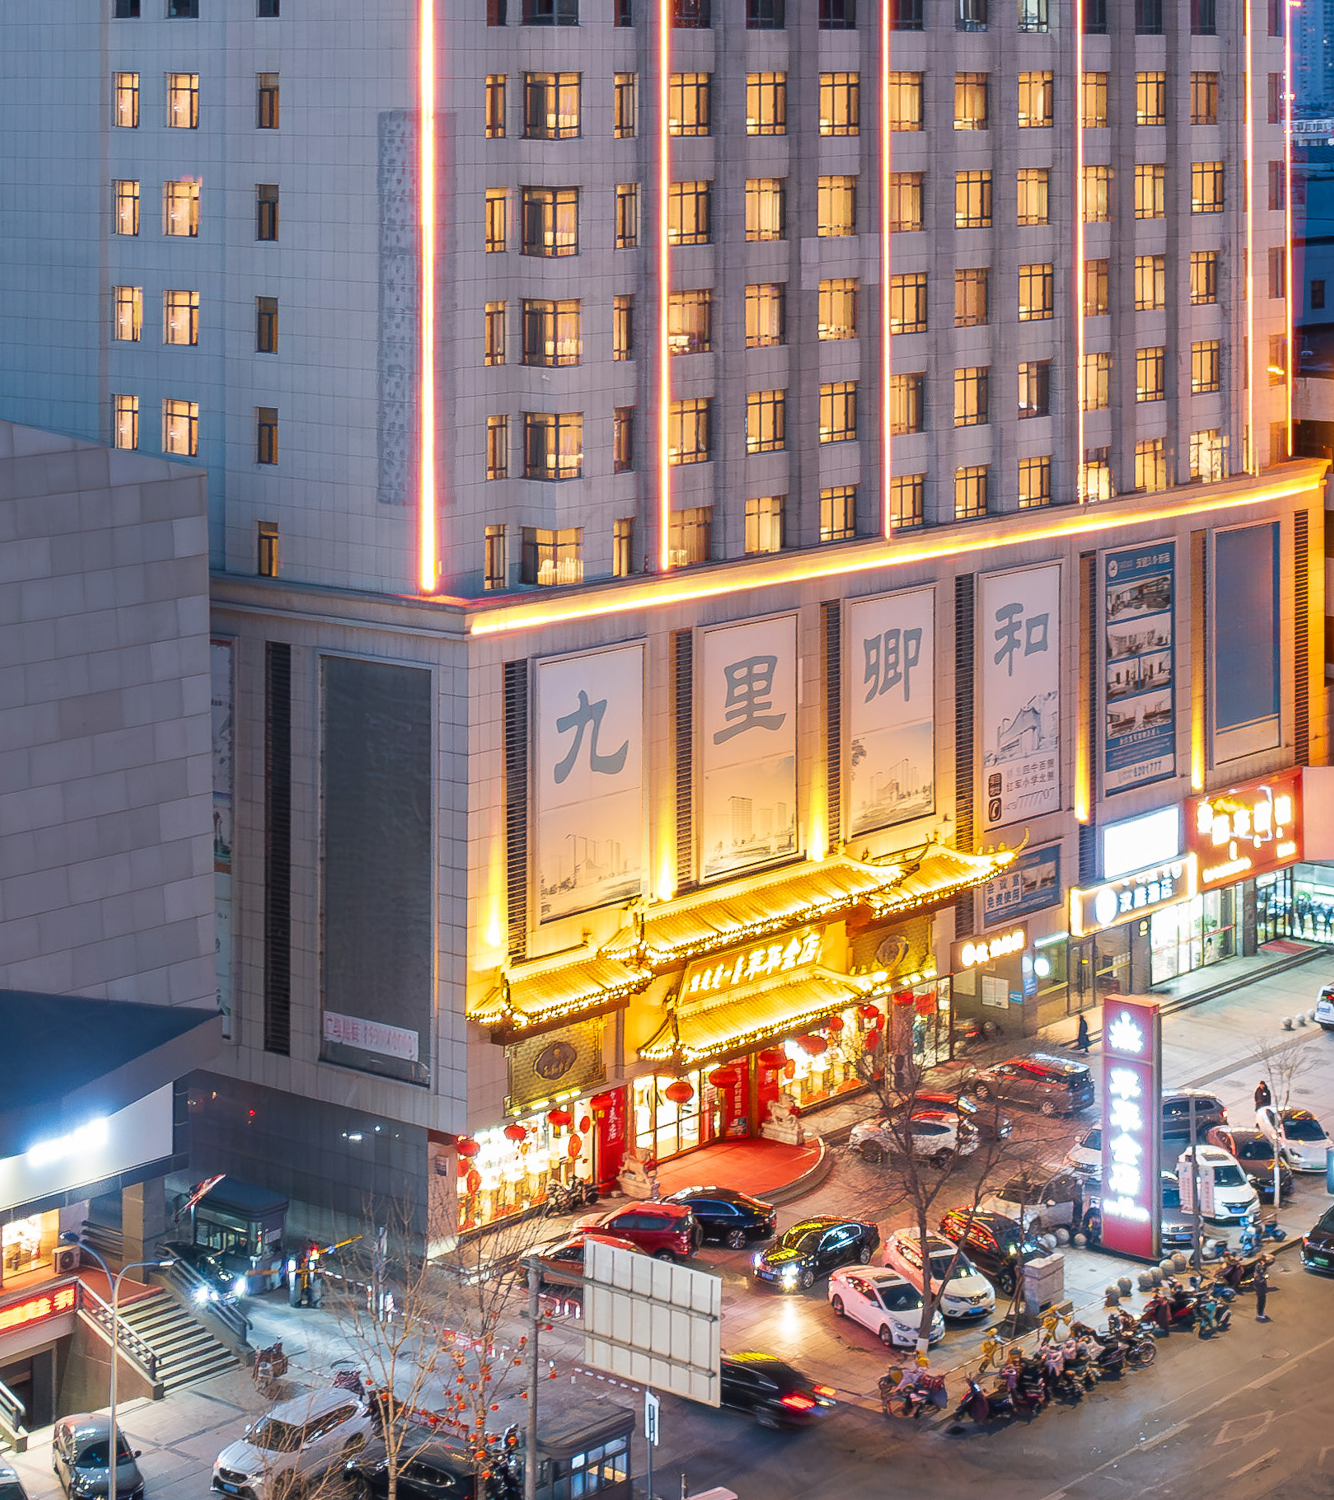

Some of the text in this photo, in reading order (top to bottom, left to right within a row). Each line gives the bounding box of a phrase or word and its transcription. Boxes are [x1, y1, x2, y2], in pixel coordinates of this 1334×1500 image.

[554, 690, 629, 784] 九
[714, 655, 786, 746] 里
[994, 602, 1050, 677] 和
[987, 888, 1020, 910] 免费使用
